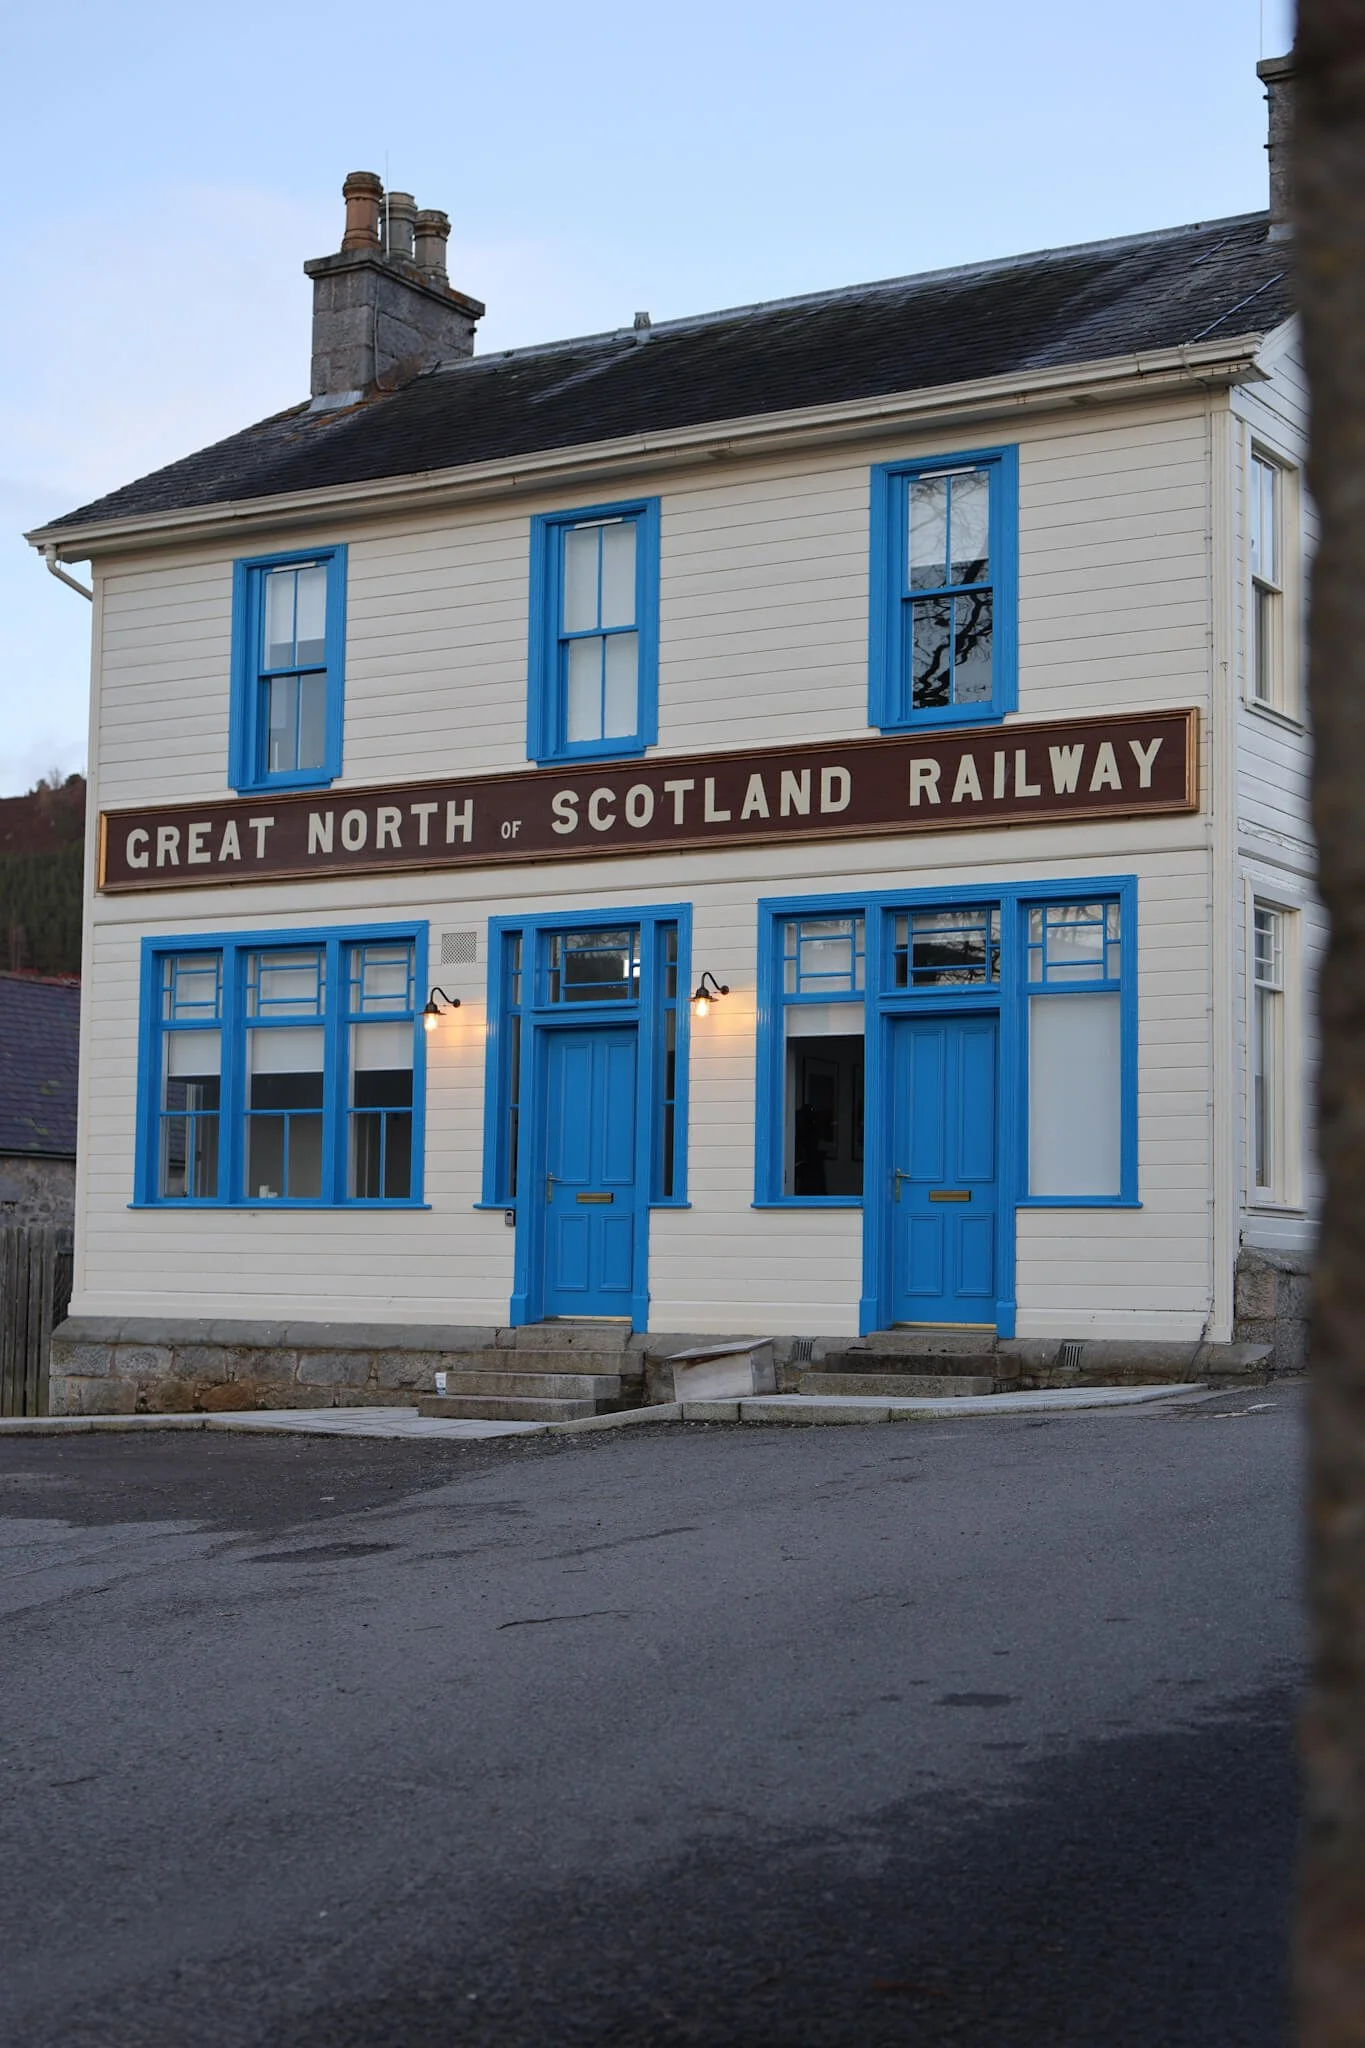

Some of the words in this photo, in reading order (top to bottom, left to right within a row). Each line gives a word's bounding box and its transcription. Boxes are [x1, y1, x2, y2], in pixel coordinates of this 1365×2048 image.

[126, 816, 275, 869] GREAT
[307, 799, 474, 855] NORTH
[500, 819, 522, 840] OF
[551, 766, 852, 836] SCOTLAND
[908, 736, 1165, 808] RAILWAY
